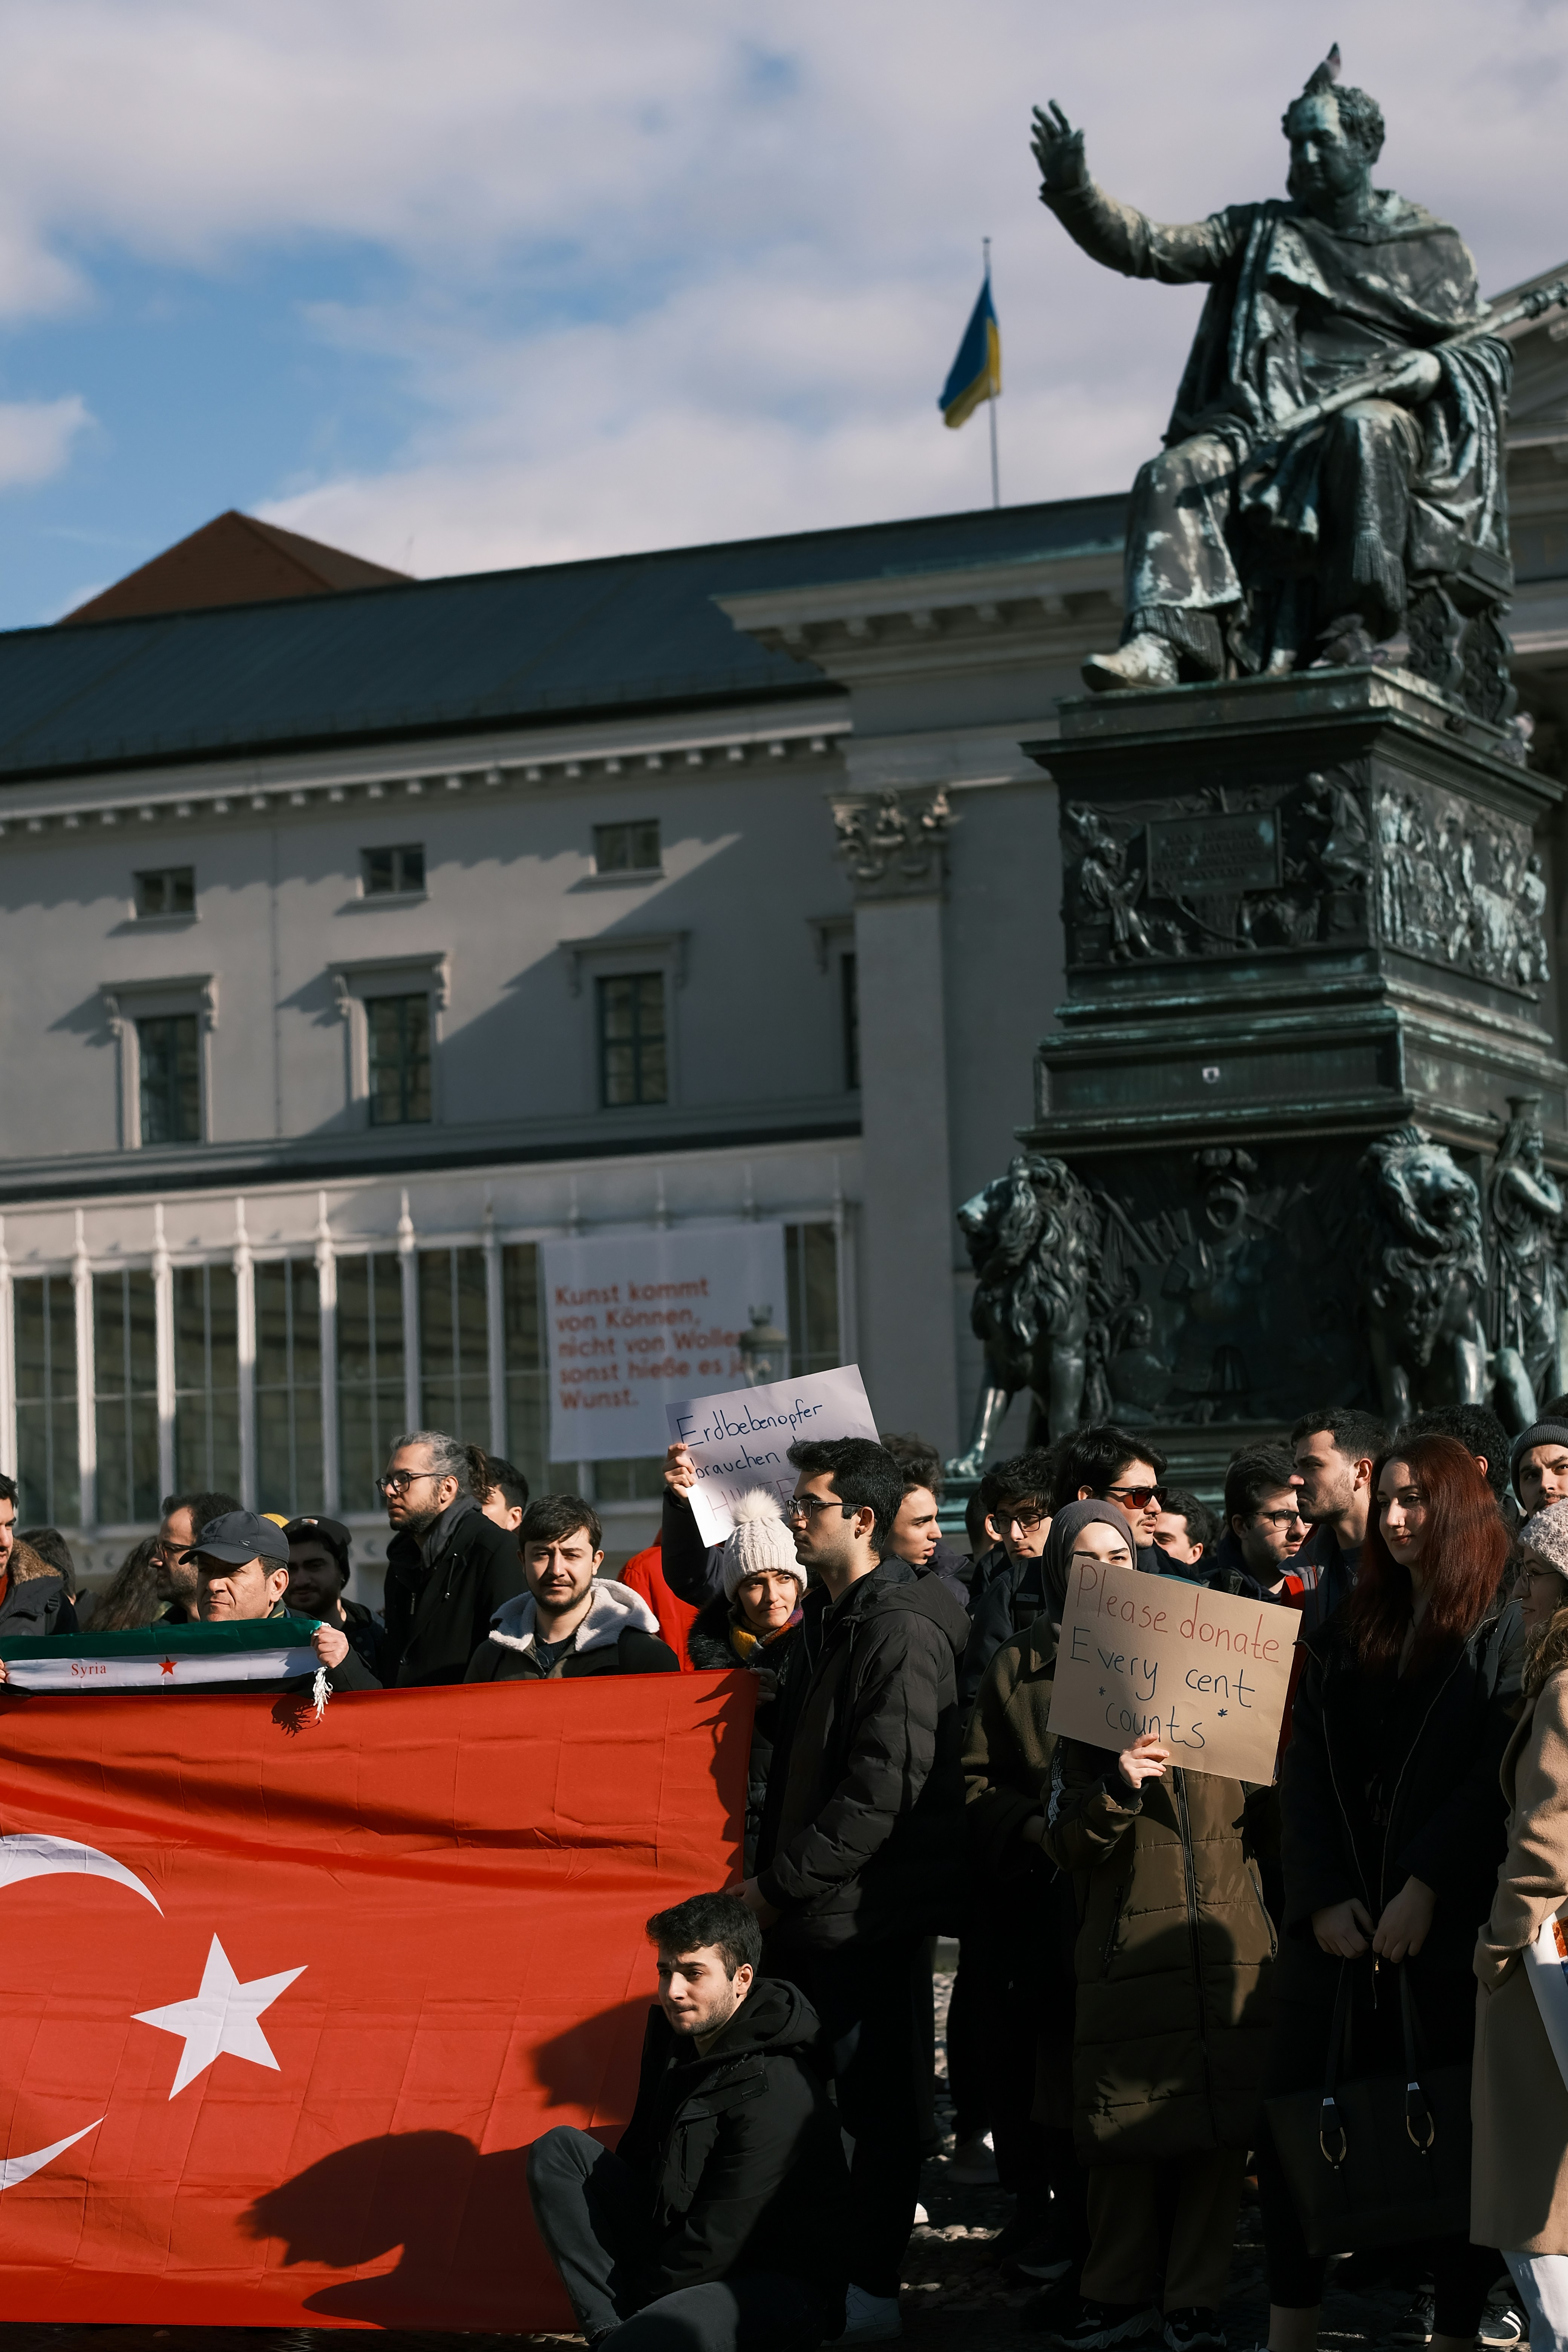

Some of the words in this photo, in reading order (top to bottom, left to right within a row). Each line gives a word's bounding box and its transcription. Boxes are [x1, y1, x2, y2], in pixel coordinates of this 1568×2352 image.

[555, 1283, 619, 1305] Kunst
[628, 1279, 709, 1301] kommt
[557, 1315, 597, 1332] von
[606, 1308, 700, 1329] Können,
[559, 1337, 615, 1357] nicht
[625, 1336, 665, 1353] von
[560, 1363, 619, 1384] sonst
[628, 1357, 690, 1380] hieße
[698, 1359, 722, 1374] es
[560, 1389, 639, 1409] Wunst.
[677, 1399, 823, 1447] Erdbebenopfer
[690, 1445, 780, 1479] brauchen
[1076, 1563, 1168, 1633] Please
[1179, 1593, 1279, 1663] donate
[71, 1662, 107, 1678] Syria
[1070, 1626, 1158, 1701] Every
[1185, 1669, 1255, 1708] cent
[1106, 1702, 1205, 1749] counts
